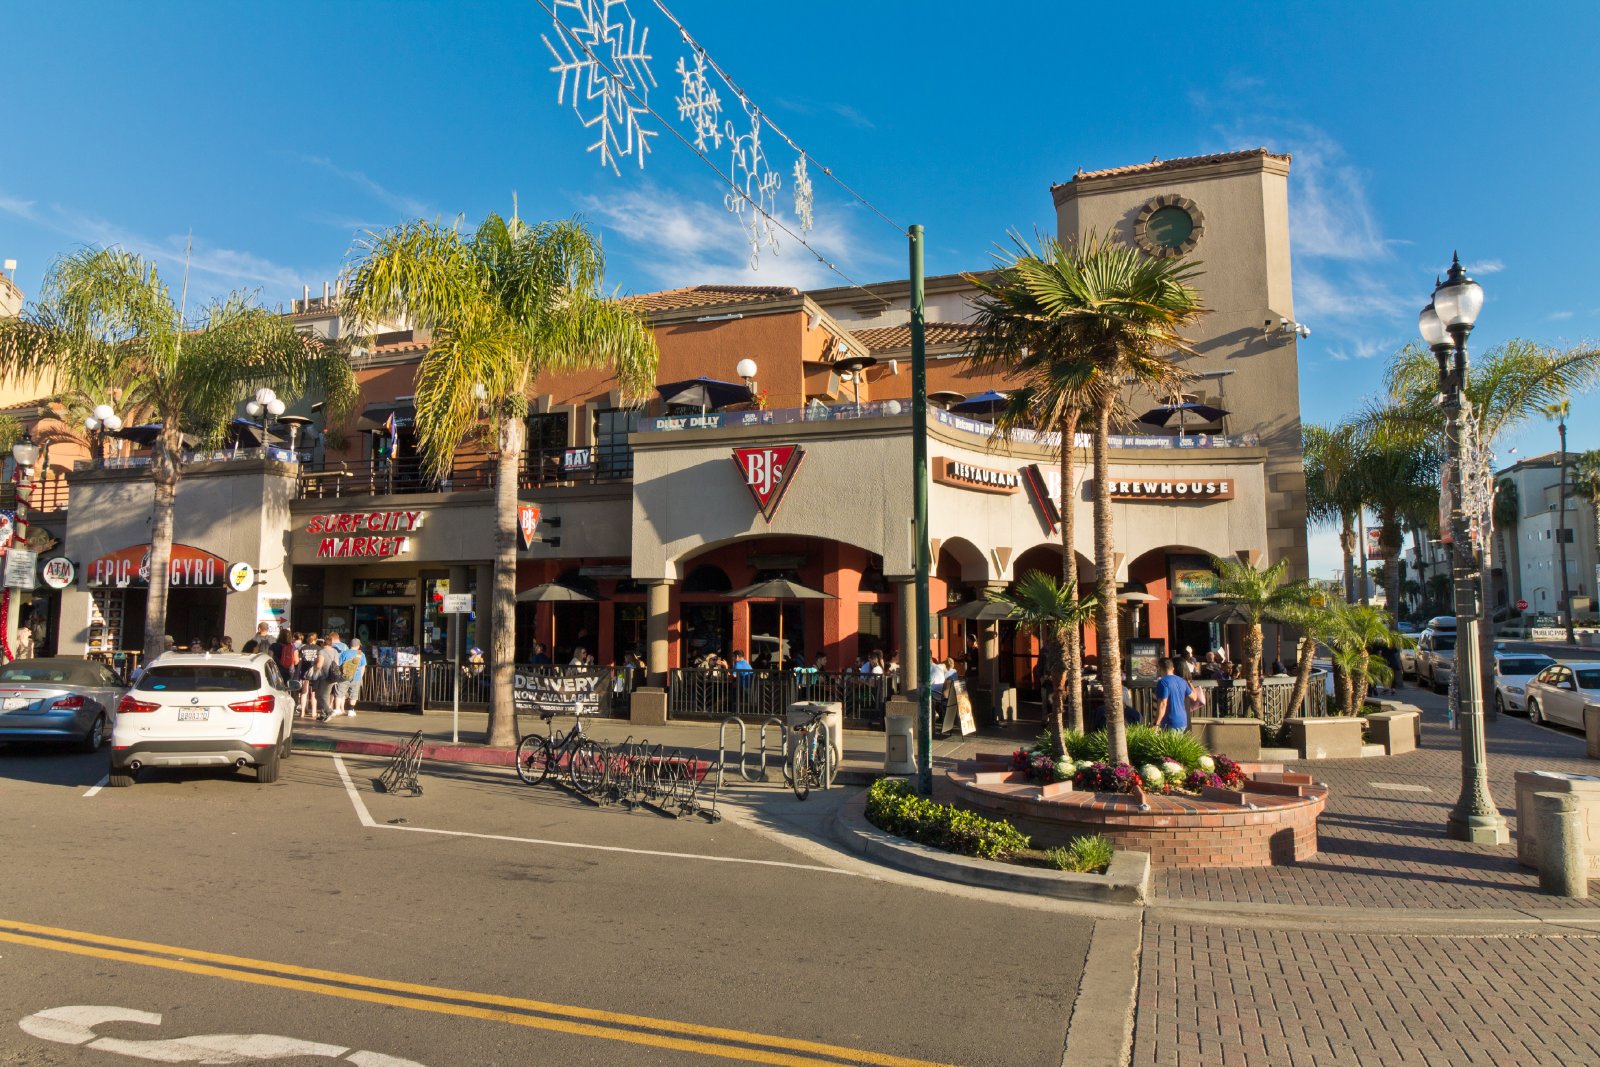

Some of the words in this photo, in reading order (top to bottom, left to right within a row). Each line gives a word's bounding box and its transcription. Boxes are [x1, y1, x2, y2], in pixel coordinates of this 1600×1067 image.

[656, 418, 688, 429] DILLY
[689, 416, 720, 427] DILLY
[1134, 437, 1170, 446] Headquarters
[746, 450, 783, 495] BJ's
[954, 461, 1022, 487] RESTAURANT
[1107, 481, 1229, 494] BREWHOUSE
[305, 513, 364, 534] SURF
[366, 511, 422, 532] CITY
[522, 508, 536, 535] BJ's
[317, 536, 407, 558] MARKET
[46, 562, 71, 577] ATM
[95, 559, 131, 586] EPIC
[171, 557, 215, 586] GYRO
[514, 674, 599, 692] DELIVERY
[514, 690, 537, 700] NOW
[540, 693, 599, 703] AVAILABLE!
